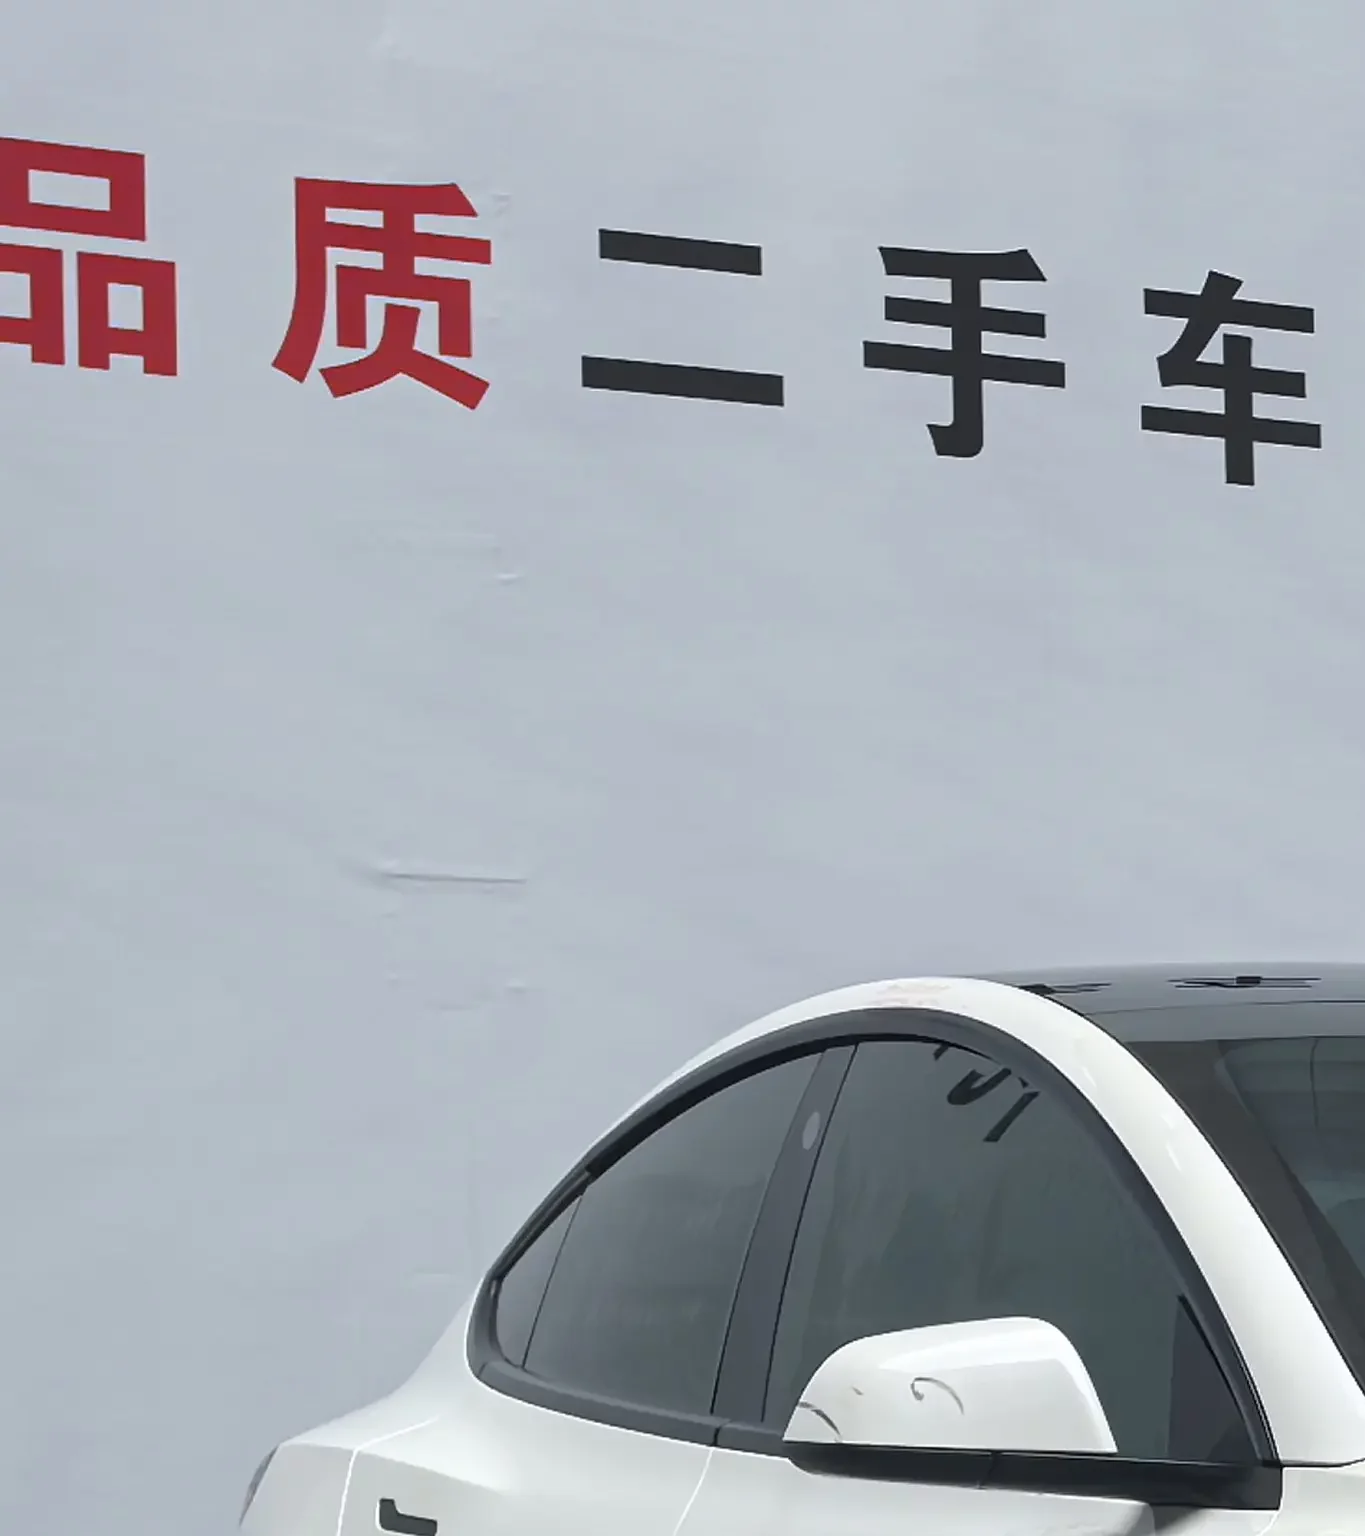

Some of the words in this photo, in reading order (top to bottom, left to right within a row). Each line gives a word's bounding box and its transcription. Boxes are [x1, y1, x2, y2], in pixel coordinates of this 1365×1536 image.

[0, 137, 1322, 487] 品质二手车
